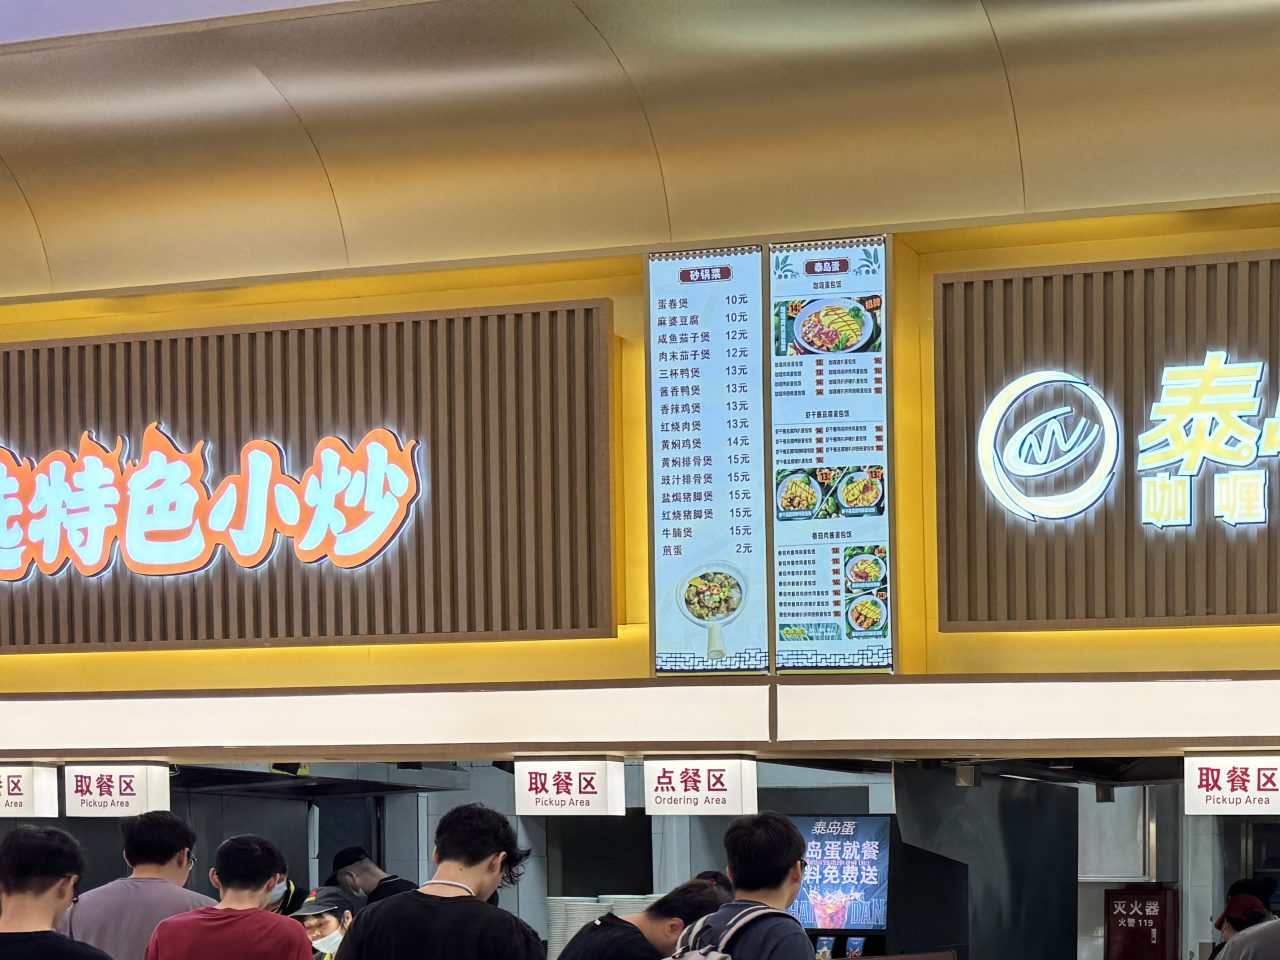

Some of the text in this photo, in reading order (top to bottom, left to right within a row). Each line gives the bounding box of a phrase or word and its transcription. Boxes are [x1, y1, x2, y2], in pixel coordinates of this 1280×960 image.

[658, 294, 748, 310] 蛋卷煲 10元
[657, 312, 748, 327] 麻婆豆腐 10元
[658, 329, 748, 344] 咸鱼茄子煲 12元
[659, 347, 748, 362] 肉末茄子煲 12元
[659, 365, 748, 379] 三杯鸭煲 13元
[726, 383, 748, 394] 13元
[660, 400, 748, 415] 香辣鸡煲 13元
[660, 418, 749, 432] 红烧肉煲 13元
[661, 436, 750, 450] 黄焖鸡煲 14元
[661, 454, 750, 468] 黄焖排骨煲 15元
[727, 472, 750, 483] 15元
[728, 489, 751, 500] 15元
[0, 436, 412, 573] 特色小炒
[662, 507, 752, 521] 红烧猪脚煲 15元
[662, 525, 752, 539] 牛腩煲 15元
[662, 543, 753, 557] 煎蛋 2元
[0, 775, 24, 796] 区
[74, 773, 137, 797] 取餐区
[528, 771, 598, 795] 取餐区
[654, 767, 728, 793] 点餐区
[1197, 766, 1279, 793] 取餐区
[80, 799, 130, 808] Pickup Area
[535, 797, 590, 808] Pickup Area
[654, 795, 727, 807] Ordering Area
[1205, 795, 1270, 806] Pickup Area
[811, 820, 856, 835] 泰岛蛋
[806, 840, 880, 860] 岛蛋就餐
[804, 865, 878, 885] 料免费送
[1113, 900, 1160, 916] 灭火器
[1118, 918, 1153, 928] 火警 119
